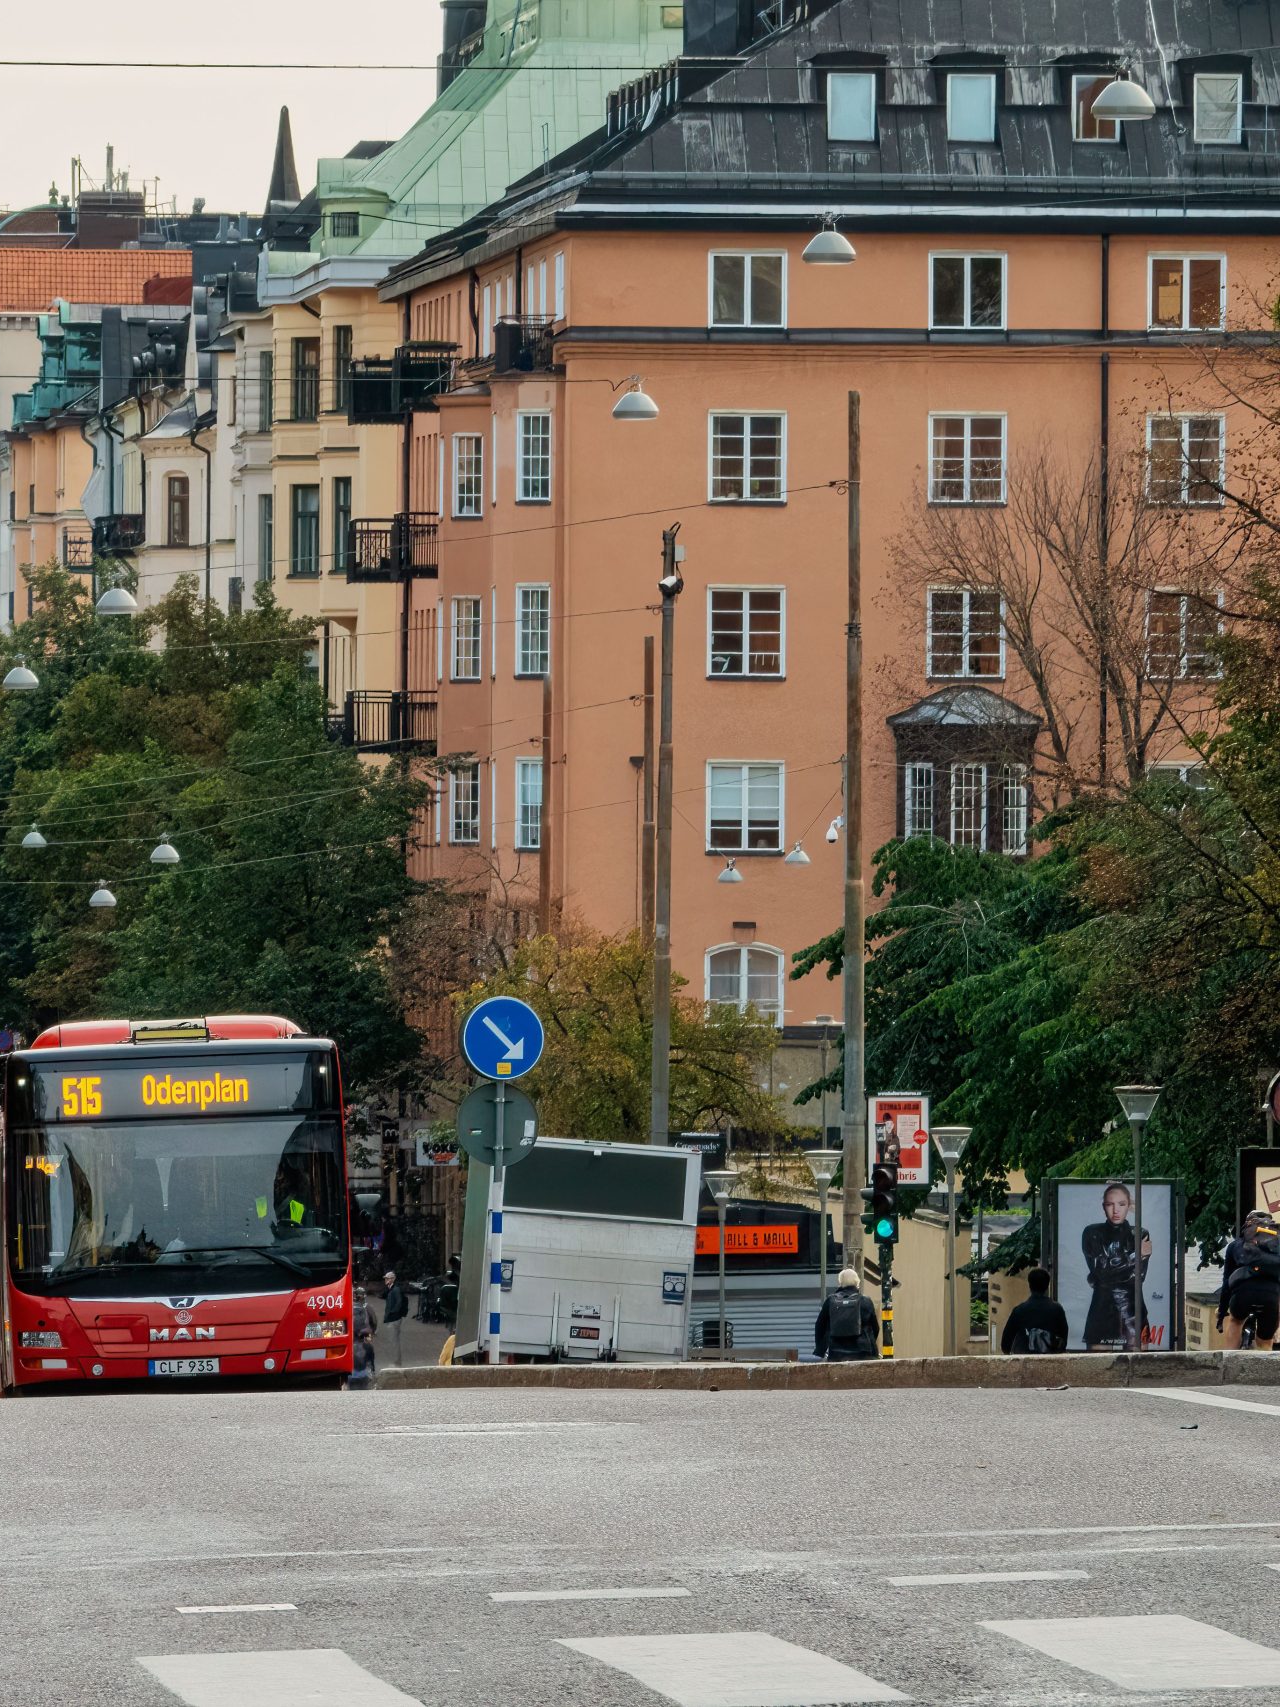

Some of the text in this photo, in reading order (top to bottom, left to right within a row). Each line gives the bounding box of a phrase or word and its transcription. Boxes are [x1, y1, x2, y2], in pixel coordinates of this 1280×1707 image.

[62, 1073, 249, 1115] 515 Odenplan
[307, 1295, 344, 1310] 4904
[150, 1327, 215, 1342] MAN
[159, 1359, 214, 1374] CLF 935
